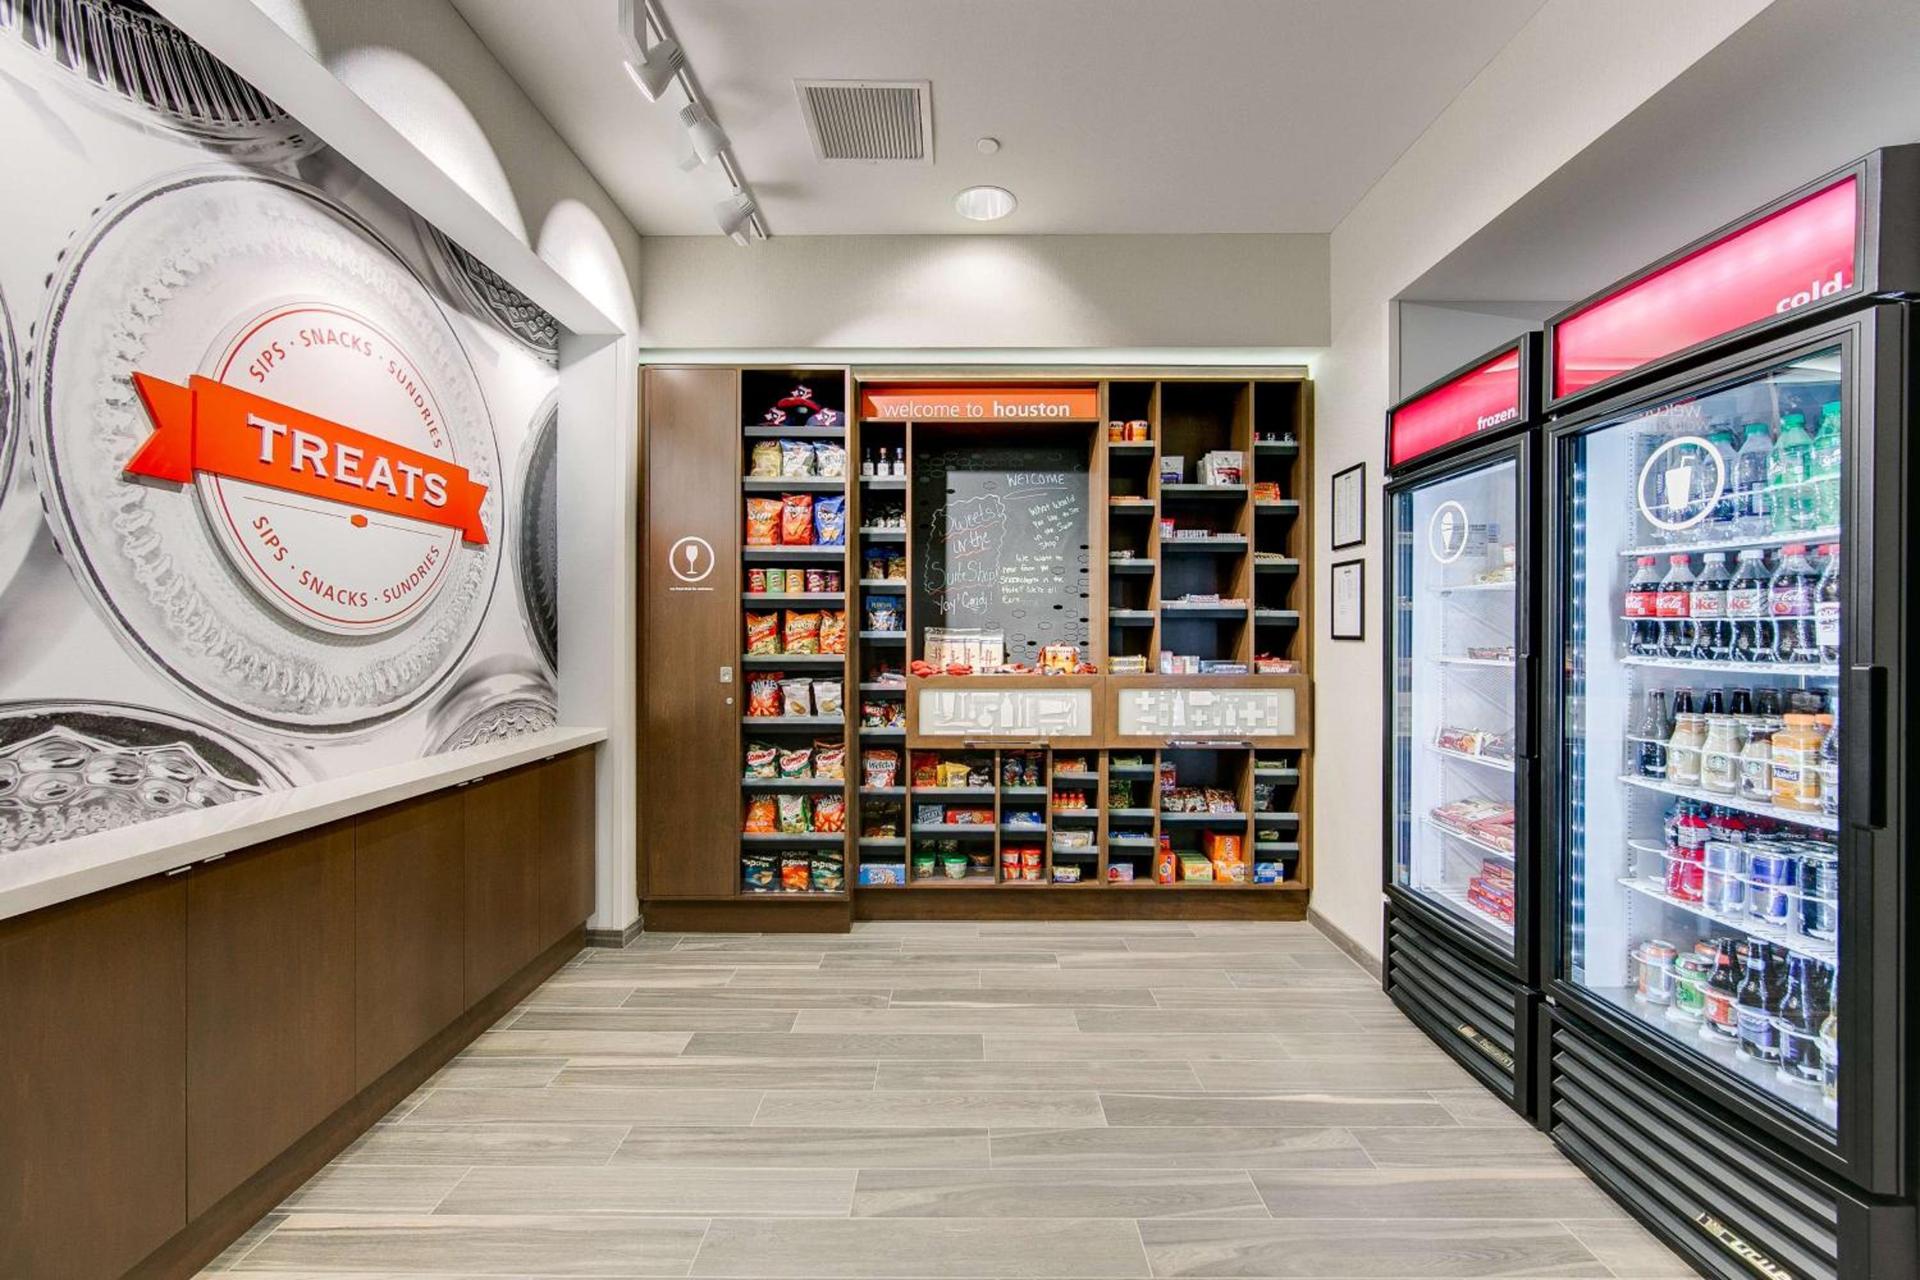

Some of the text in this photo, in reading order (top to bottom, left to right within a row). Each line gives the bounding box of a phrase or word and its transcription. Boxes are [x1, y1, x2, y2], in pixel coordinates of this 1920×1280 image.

[1776, 271, 1853, 314] cold.
[249, 327, 444, 450] SIPS SNACKS SUNDRIES
[883, 400, 1071, 418] welcome to houston
[246, 411, 449, 508] TREATS
[252, 516, 440, 608] SIPS SNACKS SUNDRIES
